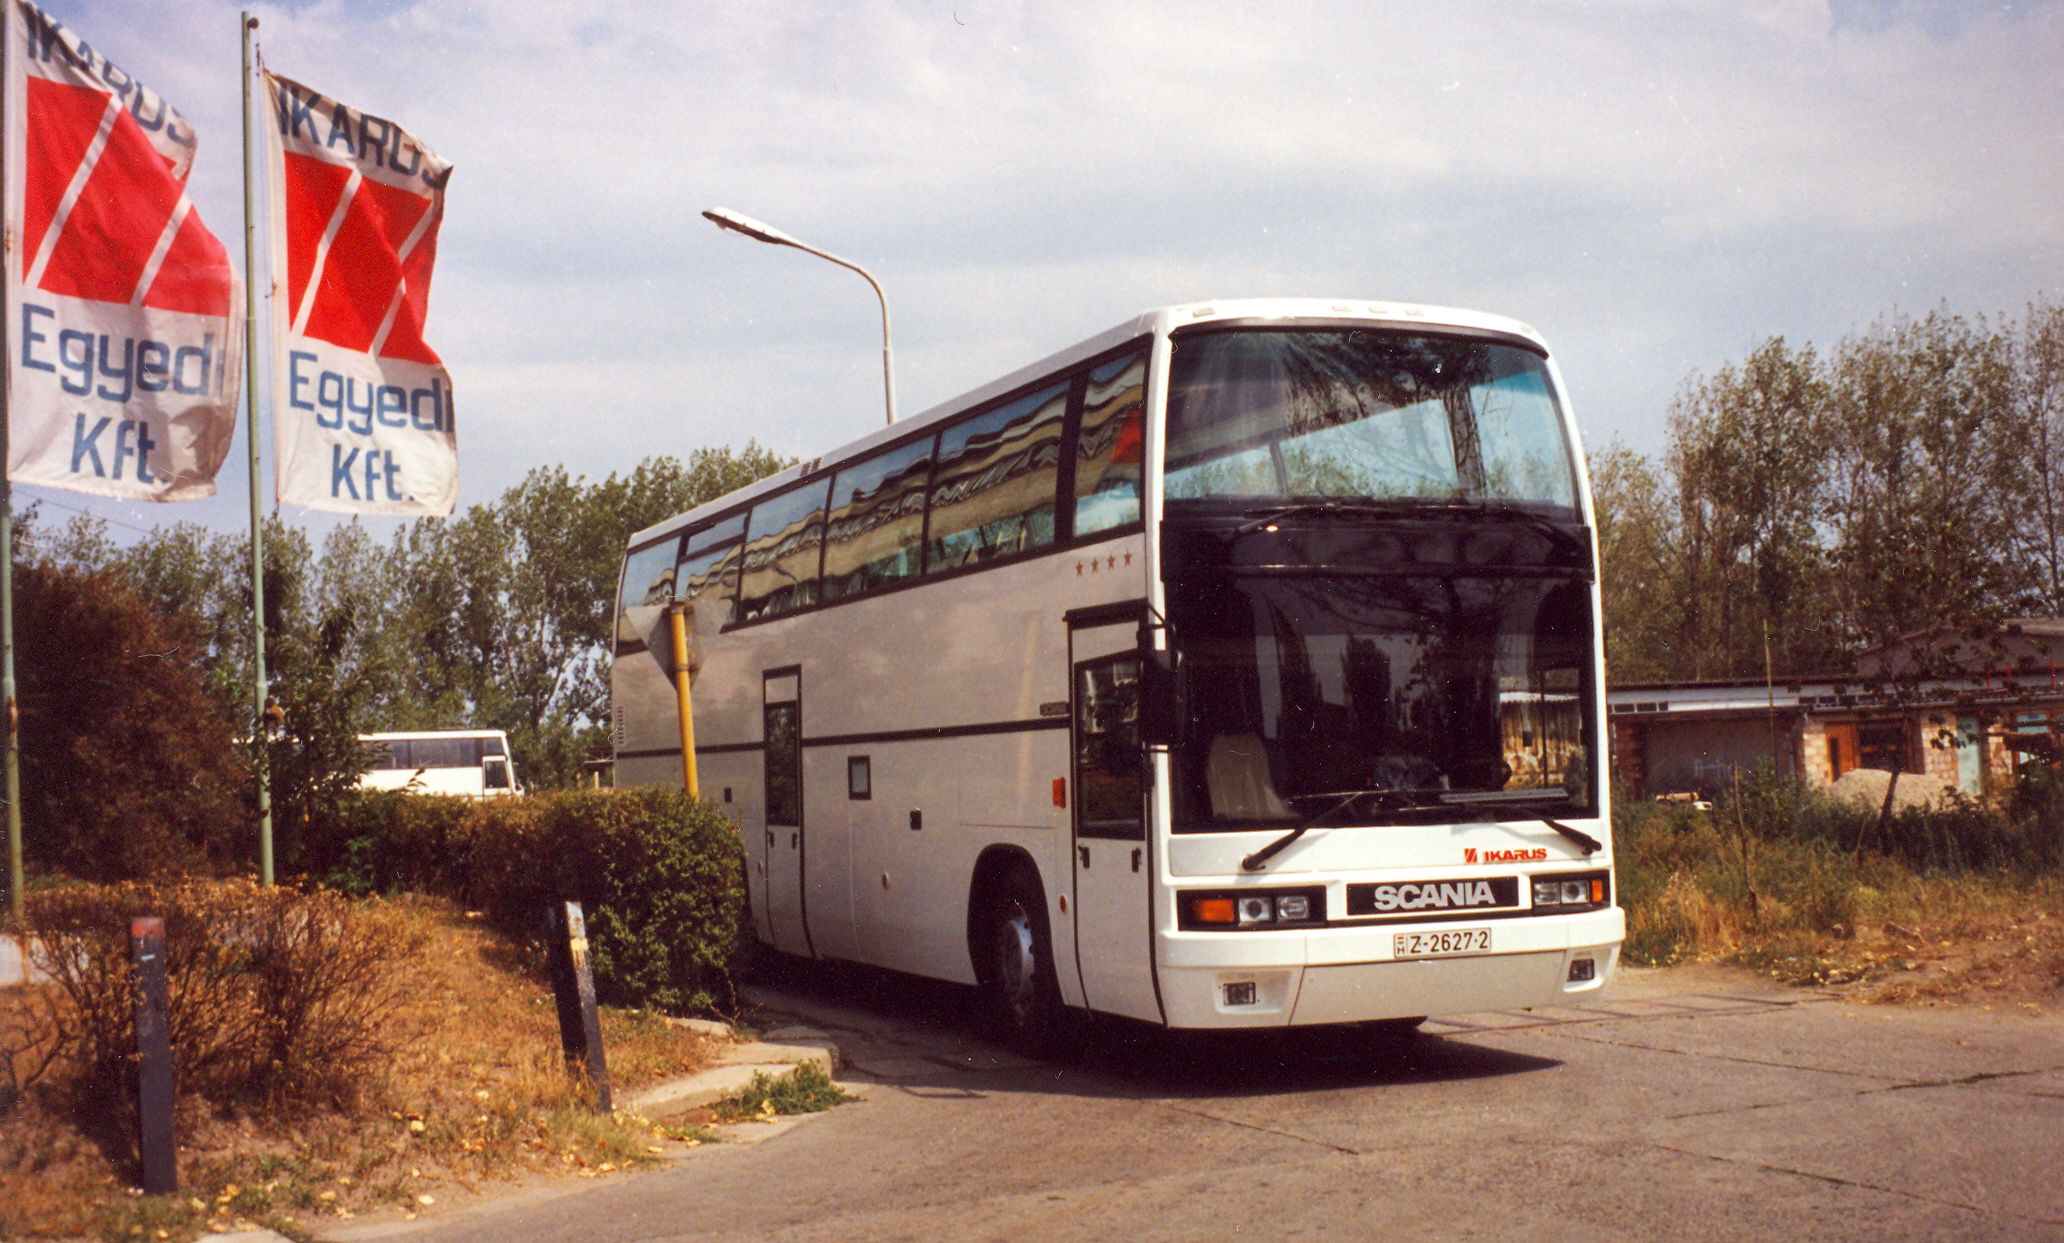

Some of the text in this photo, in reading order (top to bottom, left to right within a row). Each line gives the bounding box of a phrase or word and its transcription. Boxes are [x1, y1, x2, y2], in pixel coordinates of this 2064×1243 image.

[70, 412, 169, 485] Kft.
[331, 443, 415, 501] Kft.
[1483, 848, 1548, 863] IKARUS
[1374, 881, 1496, 911] SCANIA
